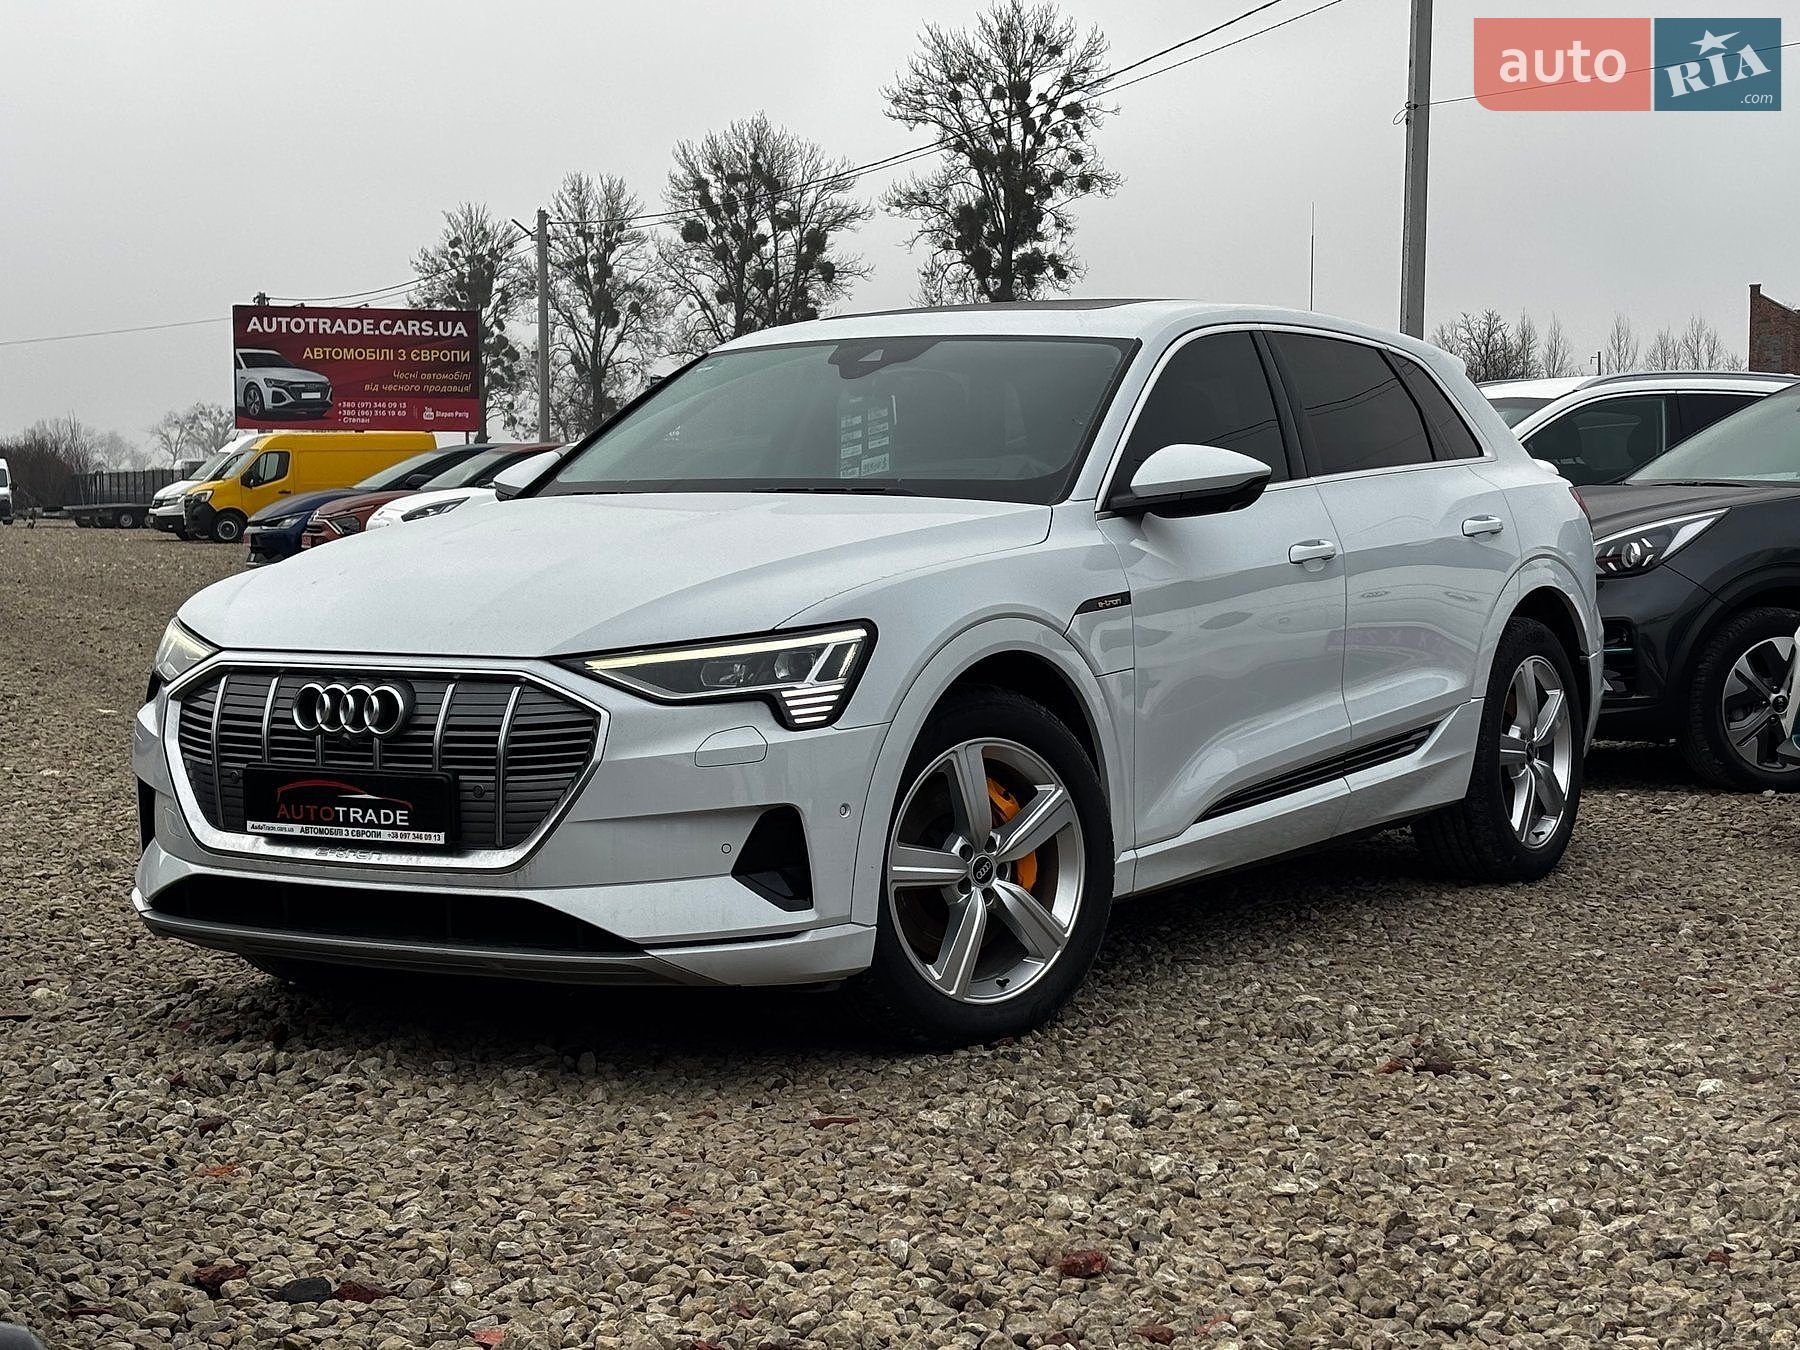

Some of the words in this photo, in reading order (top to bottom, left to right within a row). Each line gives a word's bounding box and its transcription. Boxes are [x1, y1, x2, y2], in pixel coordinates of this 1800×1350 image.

[246, 316, 469, 337] AUTOTRADE.CARS.UA
[302, 347, 394, 361] АВТОМОБІЛІ
[410, 349, 470, 362] ЄВРОПИ
[393, 369, 419, 380] Чесні
[420, 371, 472, 381] автомобілі
[364, 382, 379, 392] від
[382, 384, 421, 392] чесного
[423, 383, 472, 394] продавця!
[342, 416, 370, 424] Степан
[1097, 598, 1121, 607] e-tron
[276, 803, 410, 826] AUTOTRADE
[299, 826, 344, 837] АВТОМОБІЛІ
[350, 829, 382, 838] ЄВРОПИ
[387, 831, 399, 839] +38
[400, 832, 411, 840] 097
[412, 832, 423, 840] 346
[424, 833, 432, 841] 09
[433, 833, 441, 841] 13
